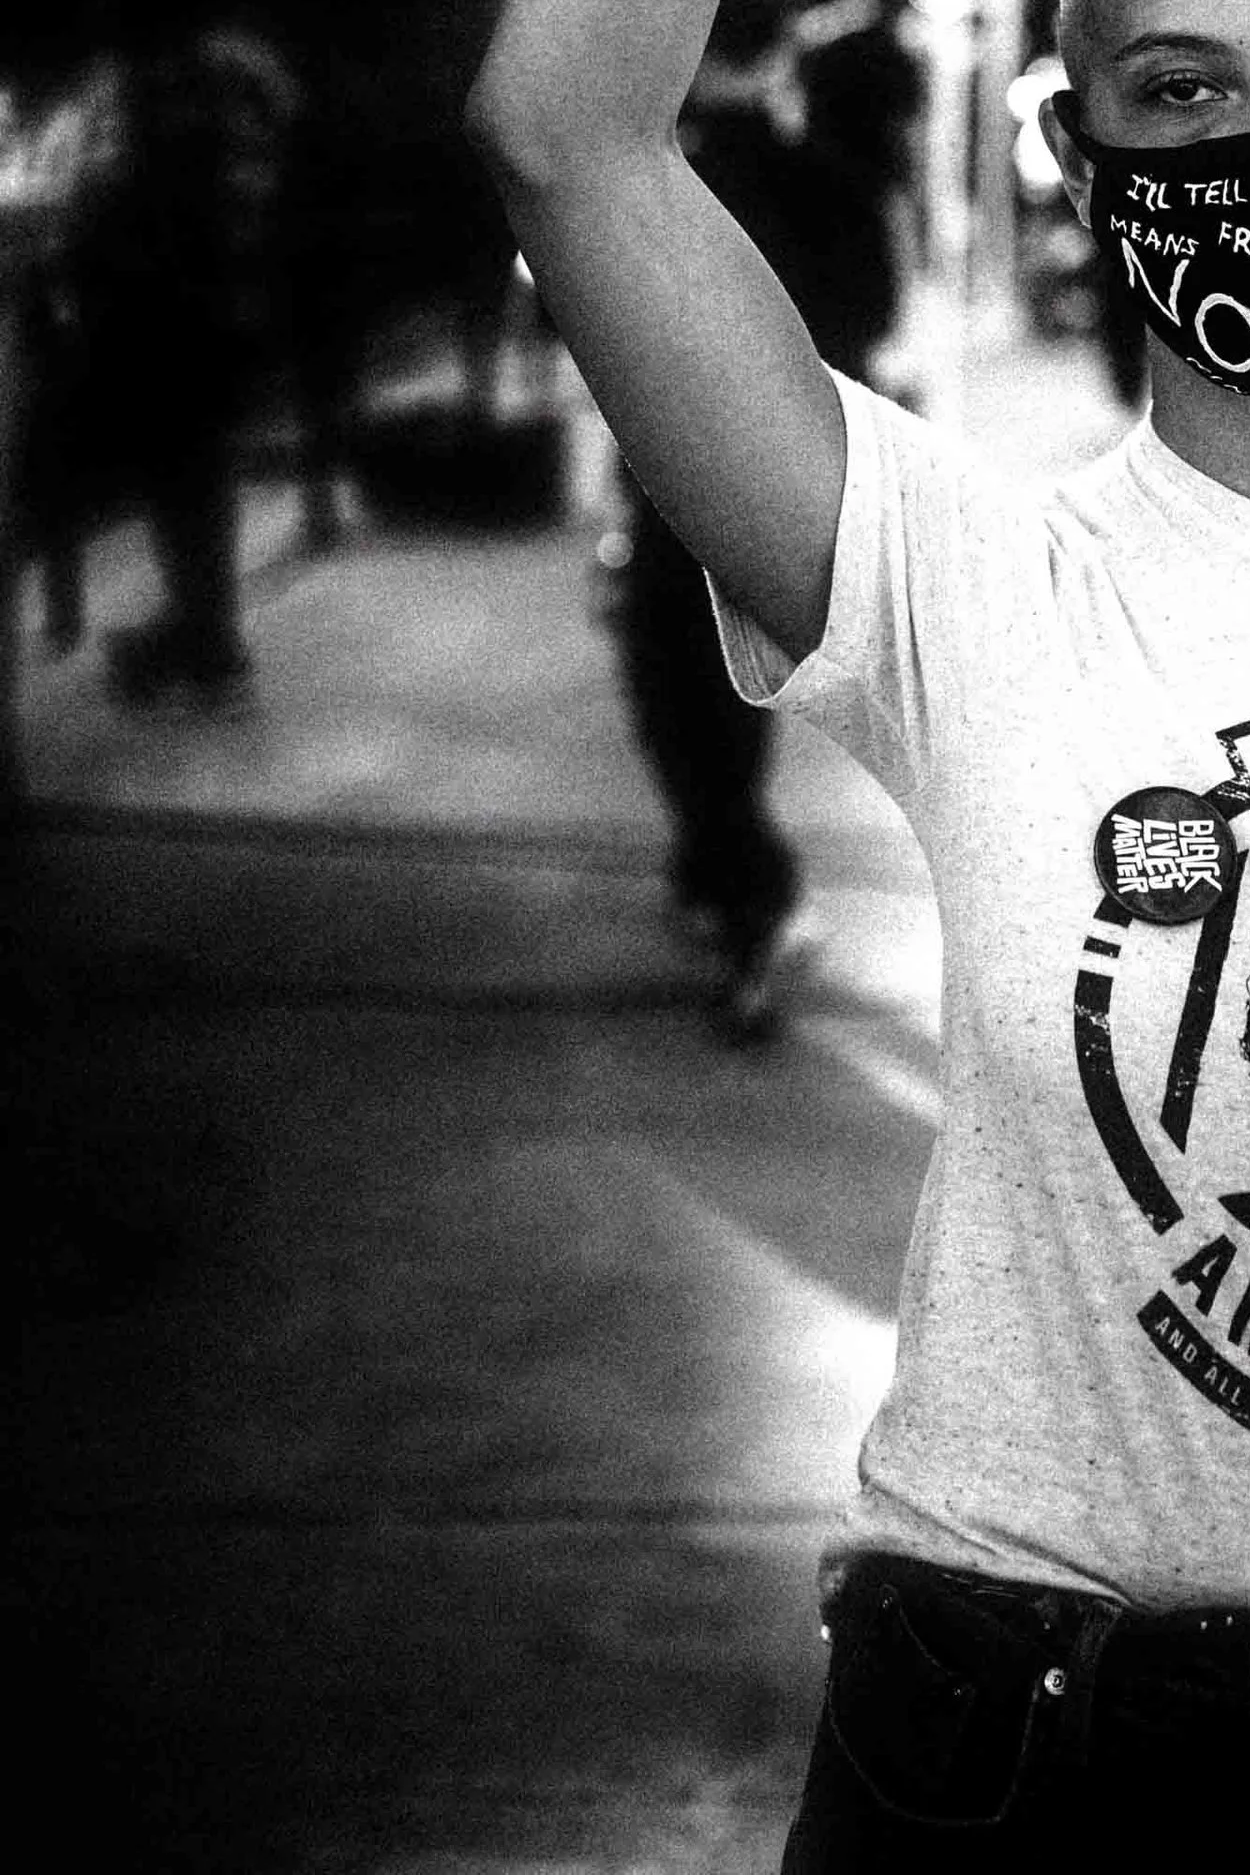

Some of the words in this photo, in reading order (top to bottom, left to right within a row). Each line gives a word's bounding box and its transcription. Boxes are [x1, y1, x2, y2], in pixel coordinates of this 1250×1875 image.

[1183, 178, 1248, 206] TELL
[1110, 214, 1200, 257] MEANS
[1110, 813, 1150, 895] MATTER
[1174, 819, 1223, 894] BLACK
[1154, 1316, 1198, 1364] AND
[1203, 1365, 1240, 1406] ALL
